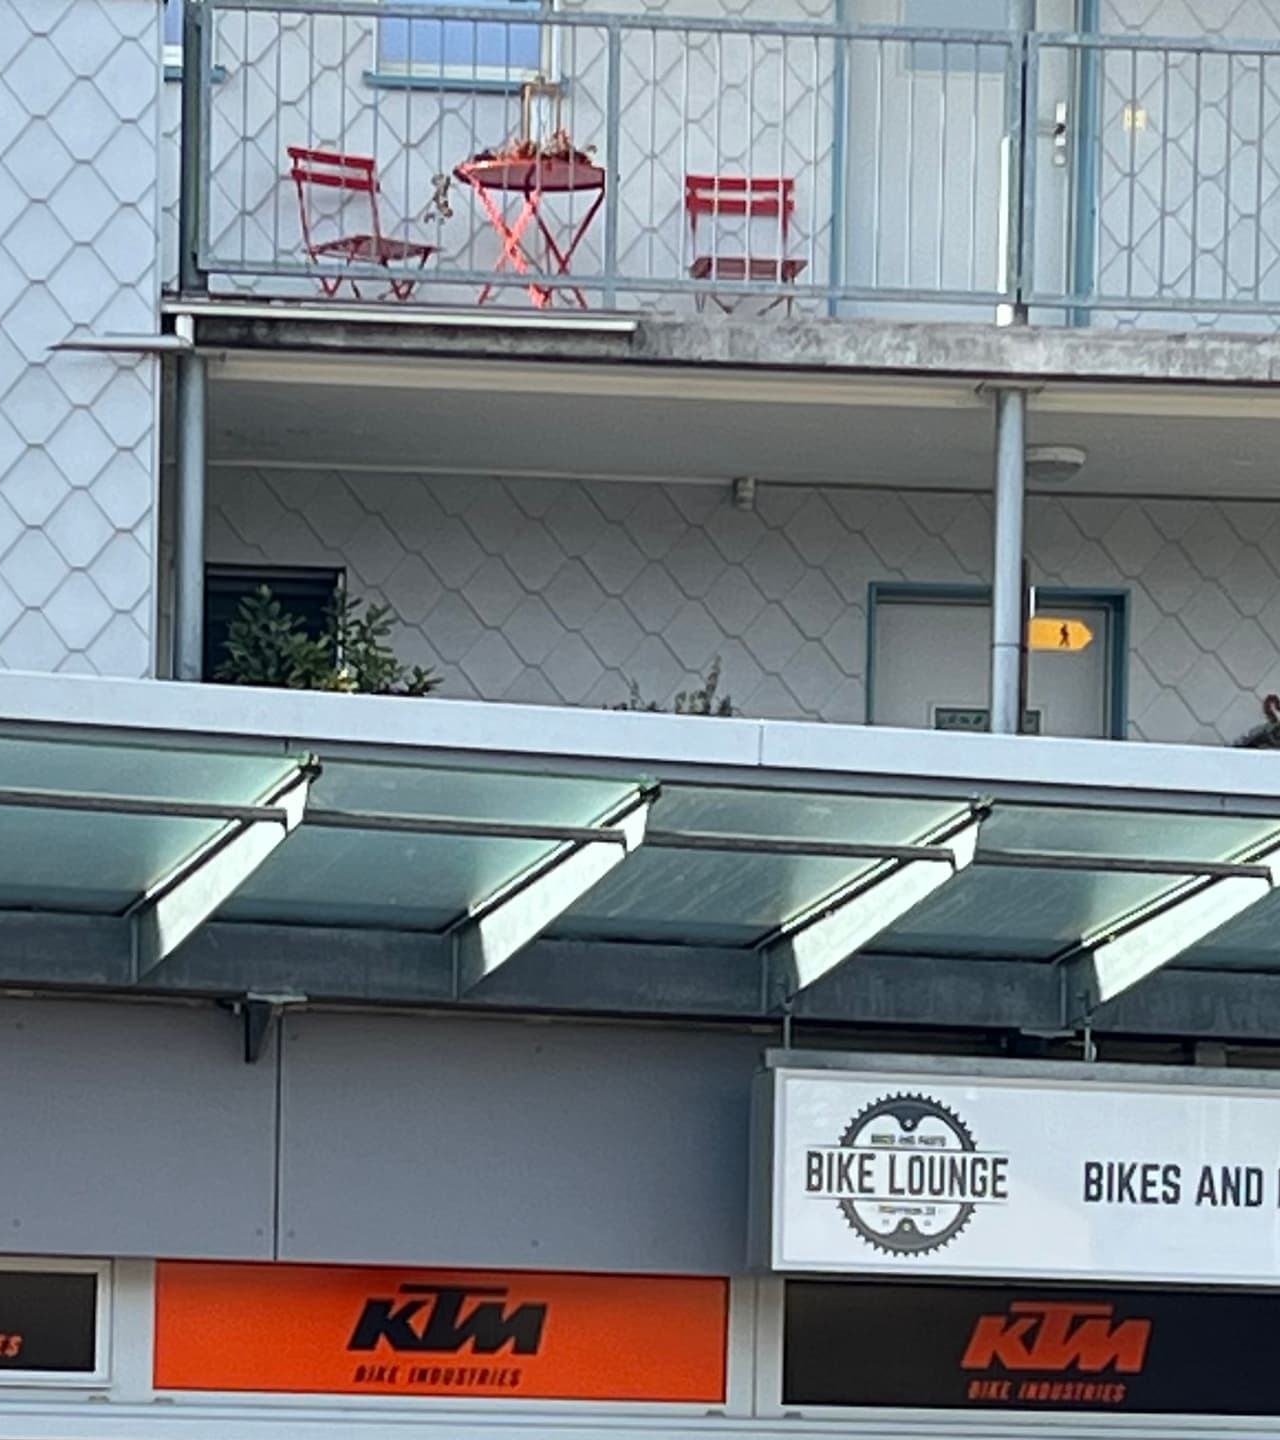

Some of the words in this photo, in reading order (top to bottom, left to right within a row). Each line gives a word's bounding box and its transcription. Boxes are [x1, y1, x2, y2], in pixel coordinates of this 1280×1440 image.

[805, 1150, 876, 1194] BIKE
[888, 1154, 1009, 1199] LOUNGE
[1083, 1161, 1182, 1205] BIKES
[1194, 1165, 1263, 1208] AND
[346, 1283, 548, 1356] KTM
[960, 1301, 1153, 1374] KTM
[353, 1364, 399, 1385] BIKE
[407, 1366, 524, 1389] INDUSTRIES
[968, 1379, 1012, 1400] BIKE
[1019, 1380, 1127, 1402] INDUSTRIES
